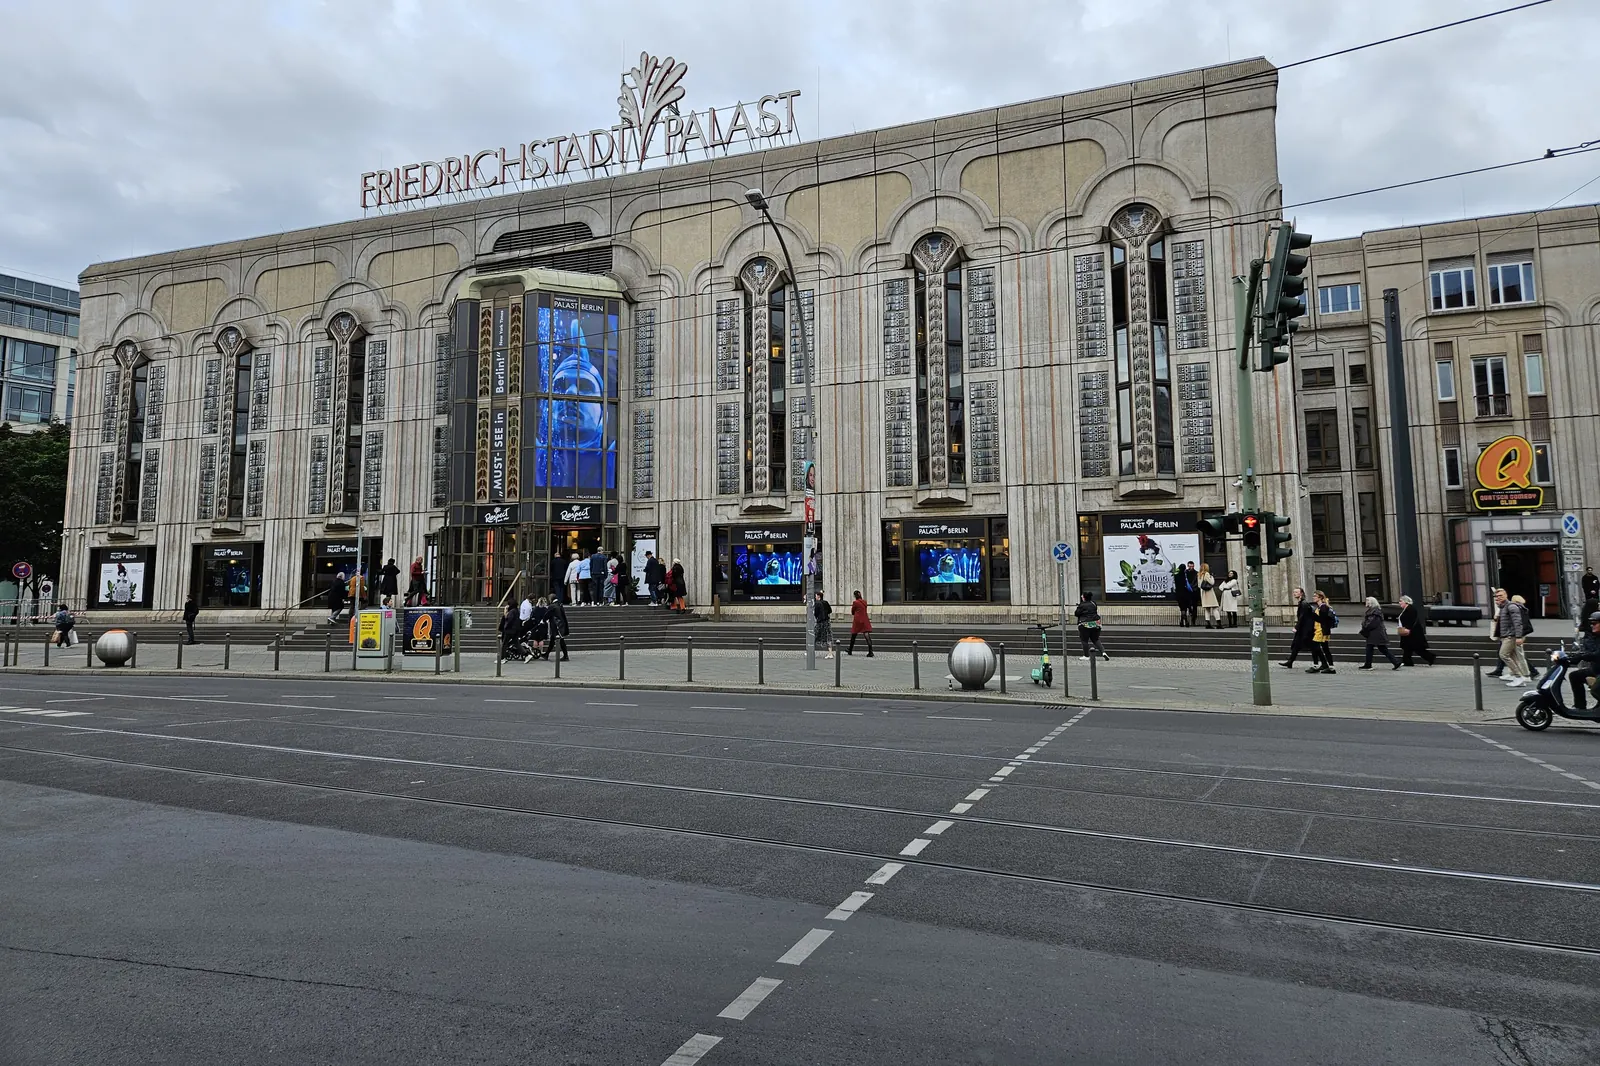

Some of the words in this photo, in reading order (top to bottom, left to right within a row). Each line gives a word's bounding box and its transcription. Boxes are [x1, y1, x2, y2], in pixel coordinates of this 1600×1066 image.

[360, 124, 632, 208] FRIEDRICHSTADT
[664, 90, 801, 154] PALAST
[554, 301, 578, 309] PALAST
[1476, 435, 1533, 489] Q
[484, 507, 510, 523] Respect
[560, 506, 591, 521] Respect
[1488, 536, 1521, 544] THEATER
[413, 614, 433, 640] Q
